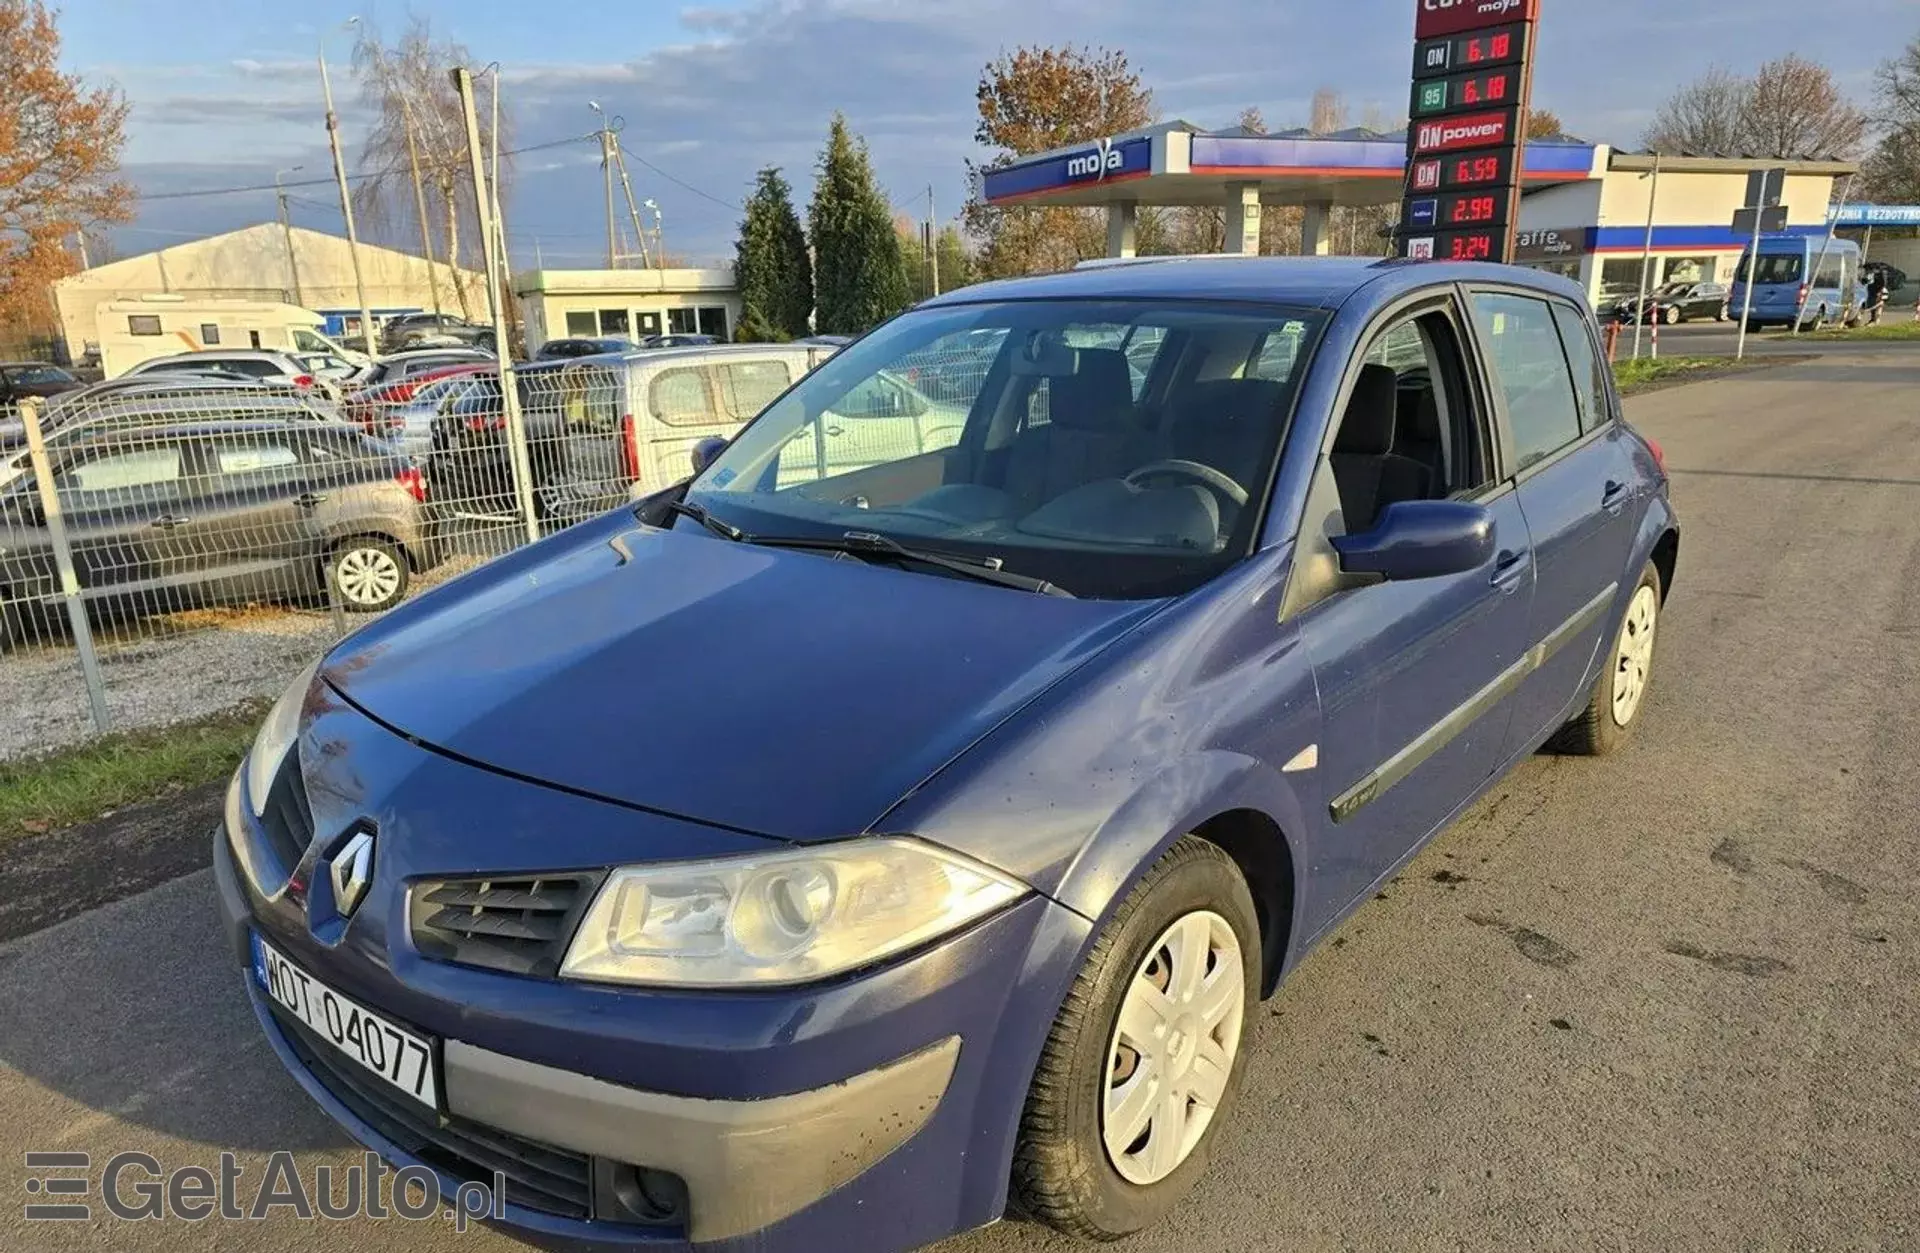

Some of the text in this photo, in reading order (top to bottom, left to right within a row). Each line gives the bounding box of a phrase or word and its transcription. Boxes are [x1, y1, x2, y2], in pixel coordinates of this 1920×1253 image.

[1427, 48, 1444, 66] ON
[1425, 88, 1440, 105] 95
[1419, 123, 1503, 148] ON power
[1068, 137, 1123, 182] moya
[1417, 157, 1497, 186] ON 6.59
[1453, 197, 1494, 222] 2.99
[1452, 236, 1490, 260] 3.24
[262, 943, 429, 1096] WOT 04077
